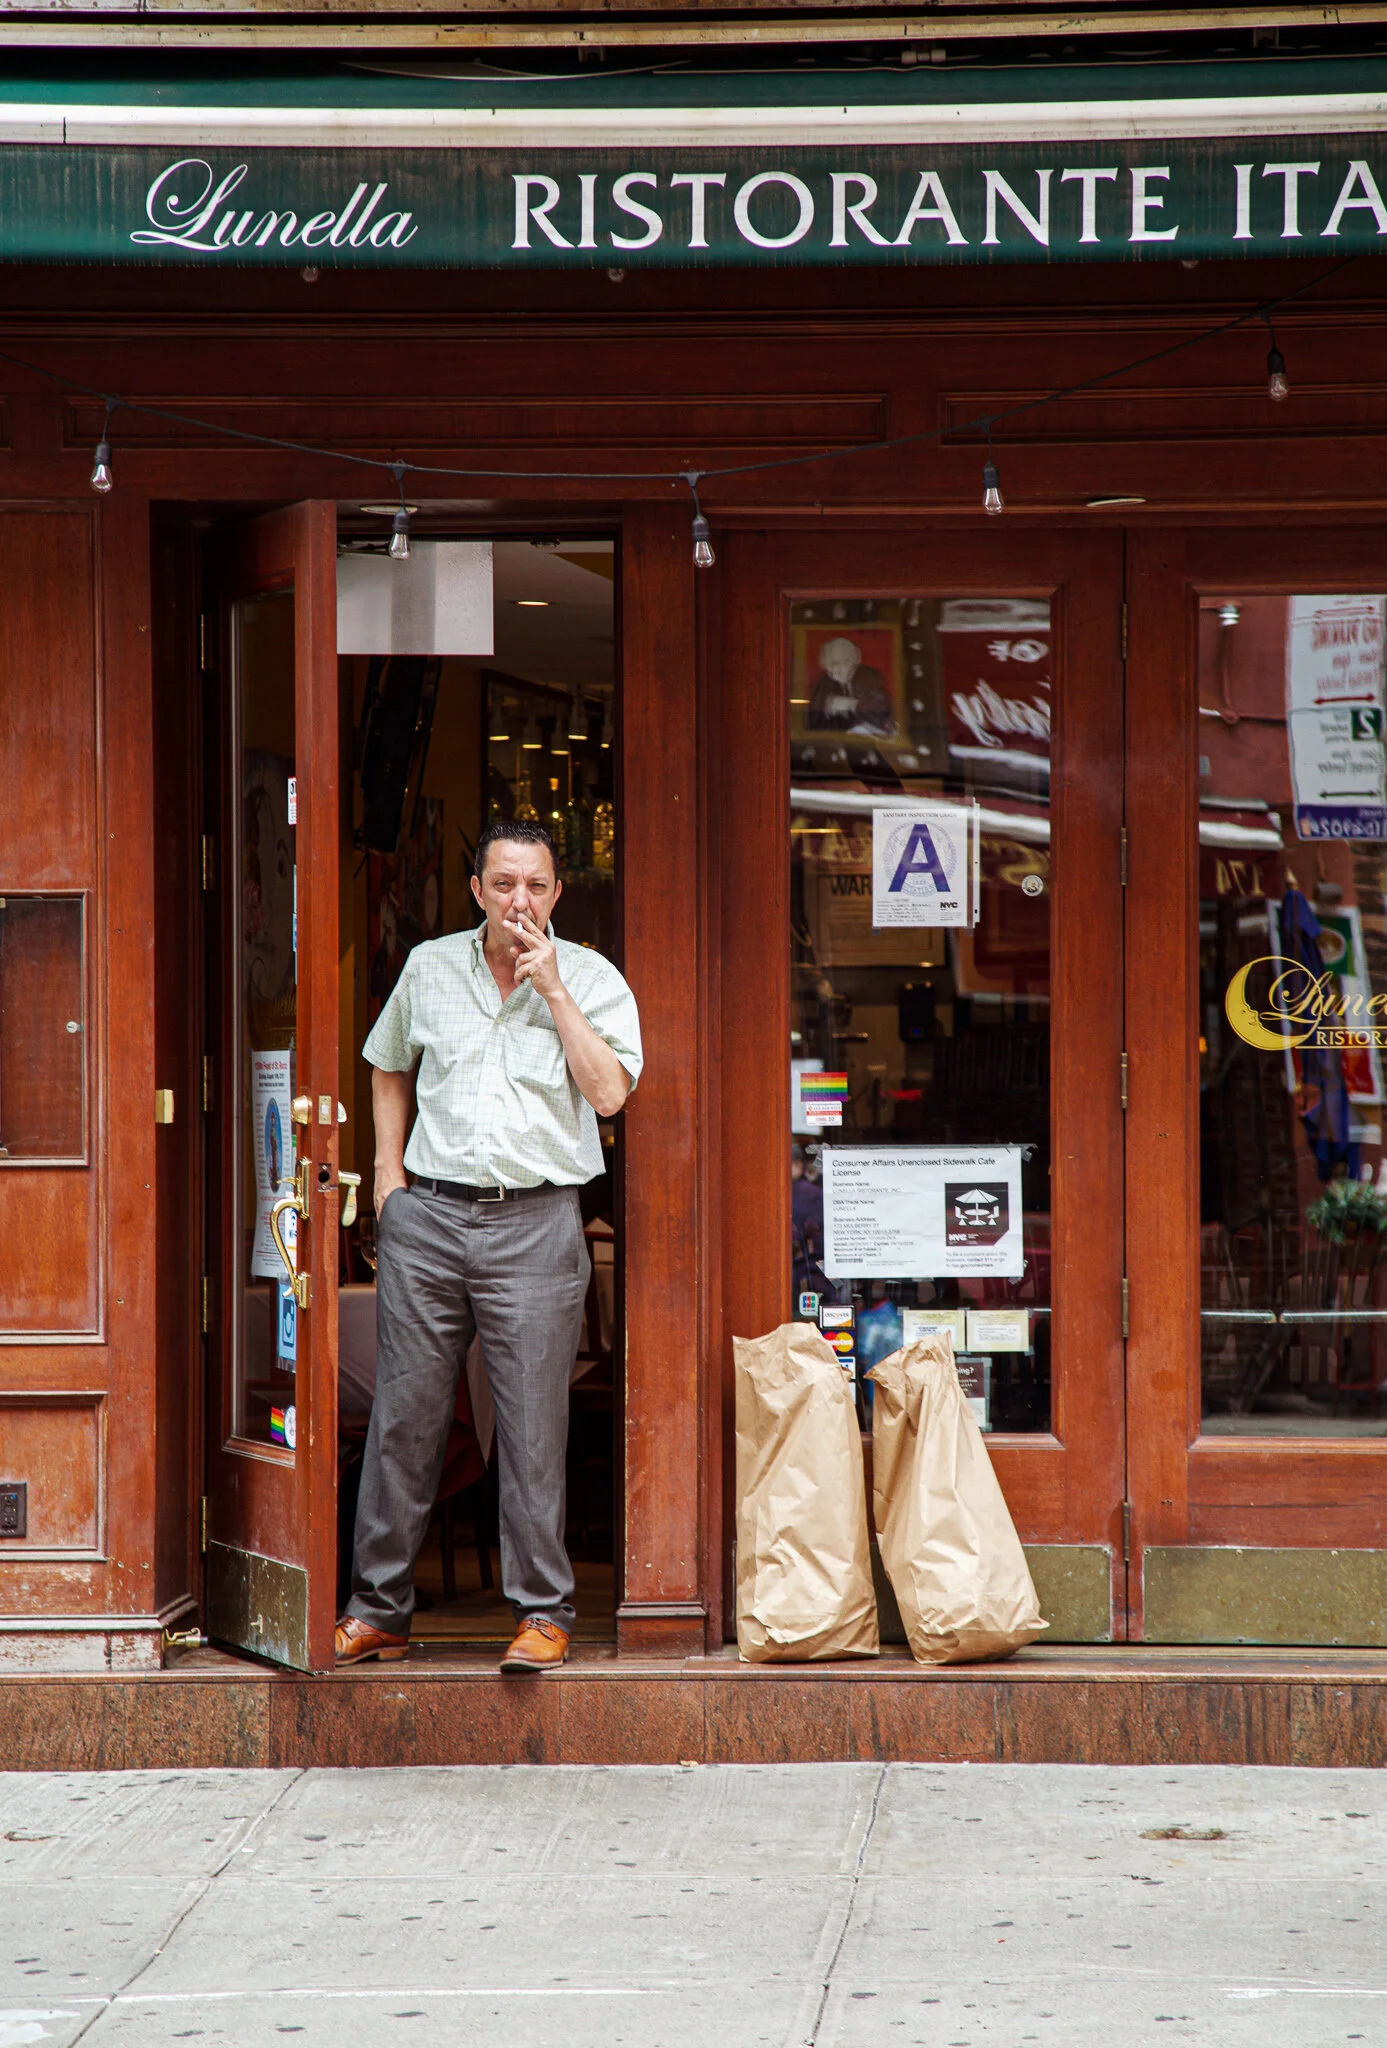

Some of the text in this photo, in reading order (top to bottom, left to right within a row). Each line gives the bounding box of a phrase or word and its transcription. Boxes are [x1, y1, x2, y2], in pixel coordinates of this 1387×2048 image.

[129, 158, 418, 251] Lunella
[510, 160, 1387, 249] RISTORANTE ITA
[888, 823, 951, 892] A
[1316, 1030, 1387, 1046] RISTOR
[832, 1159, 870, 1167] Consumer
[897, 1158, 941, 1167] Unenclosed
[943, 1157, 976, 1166] Sidewalk
[978, 1157, 996, 1165] Cafe
[832, 1169, 861, 1177] License
